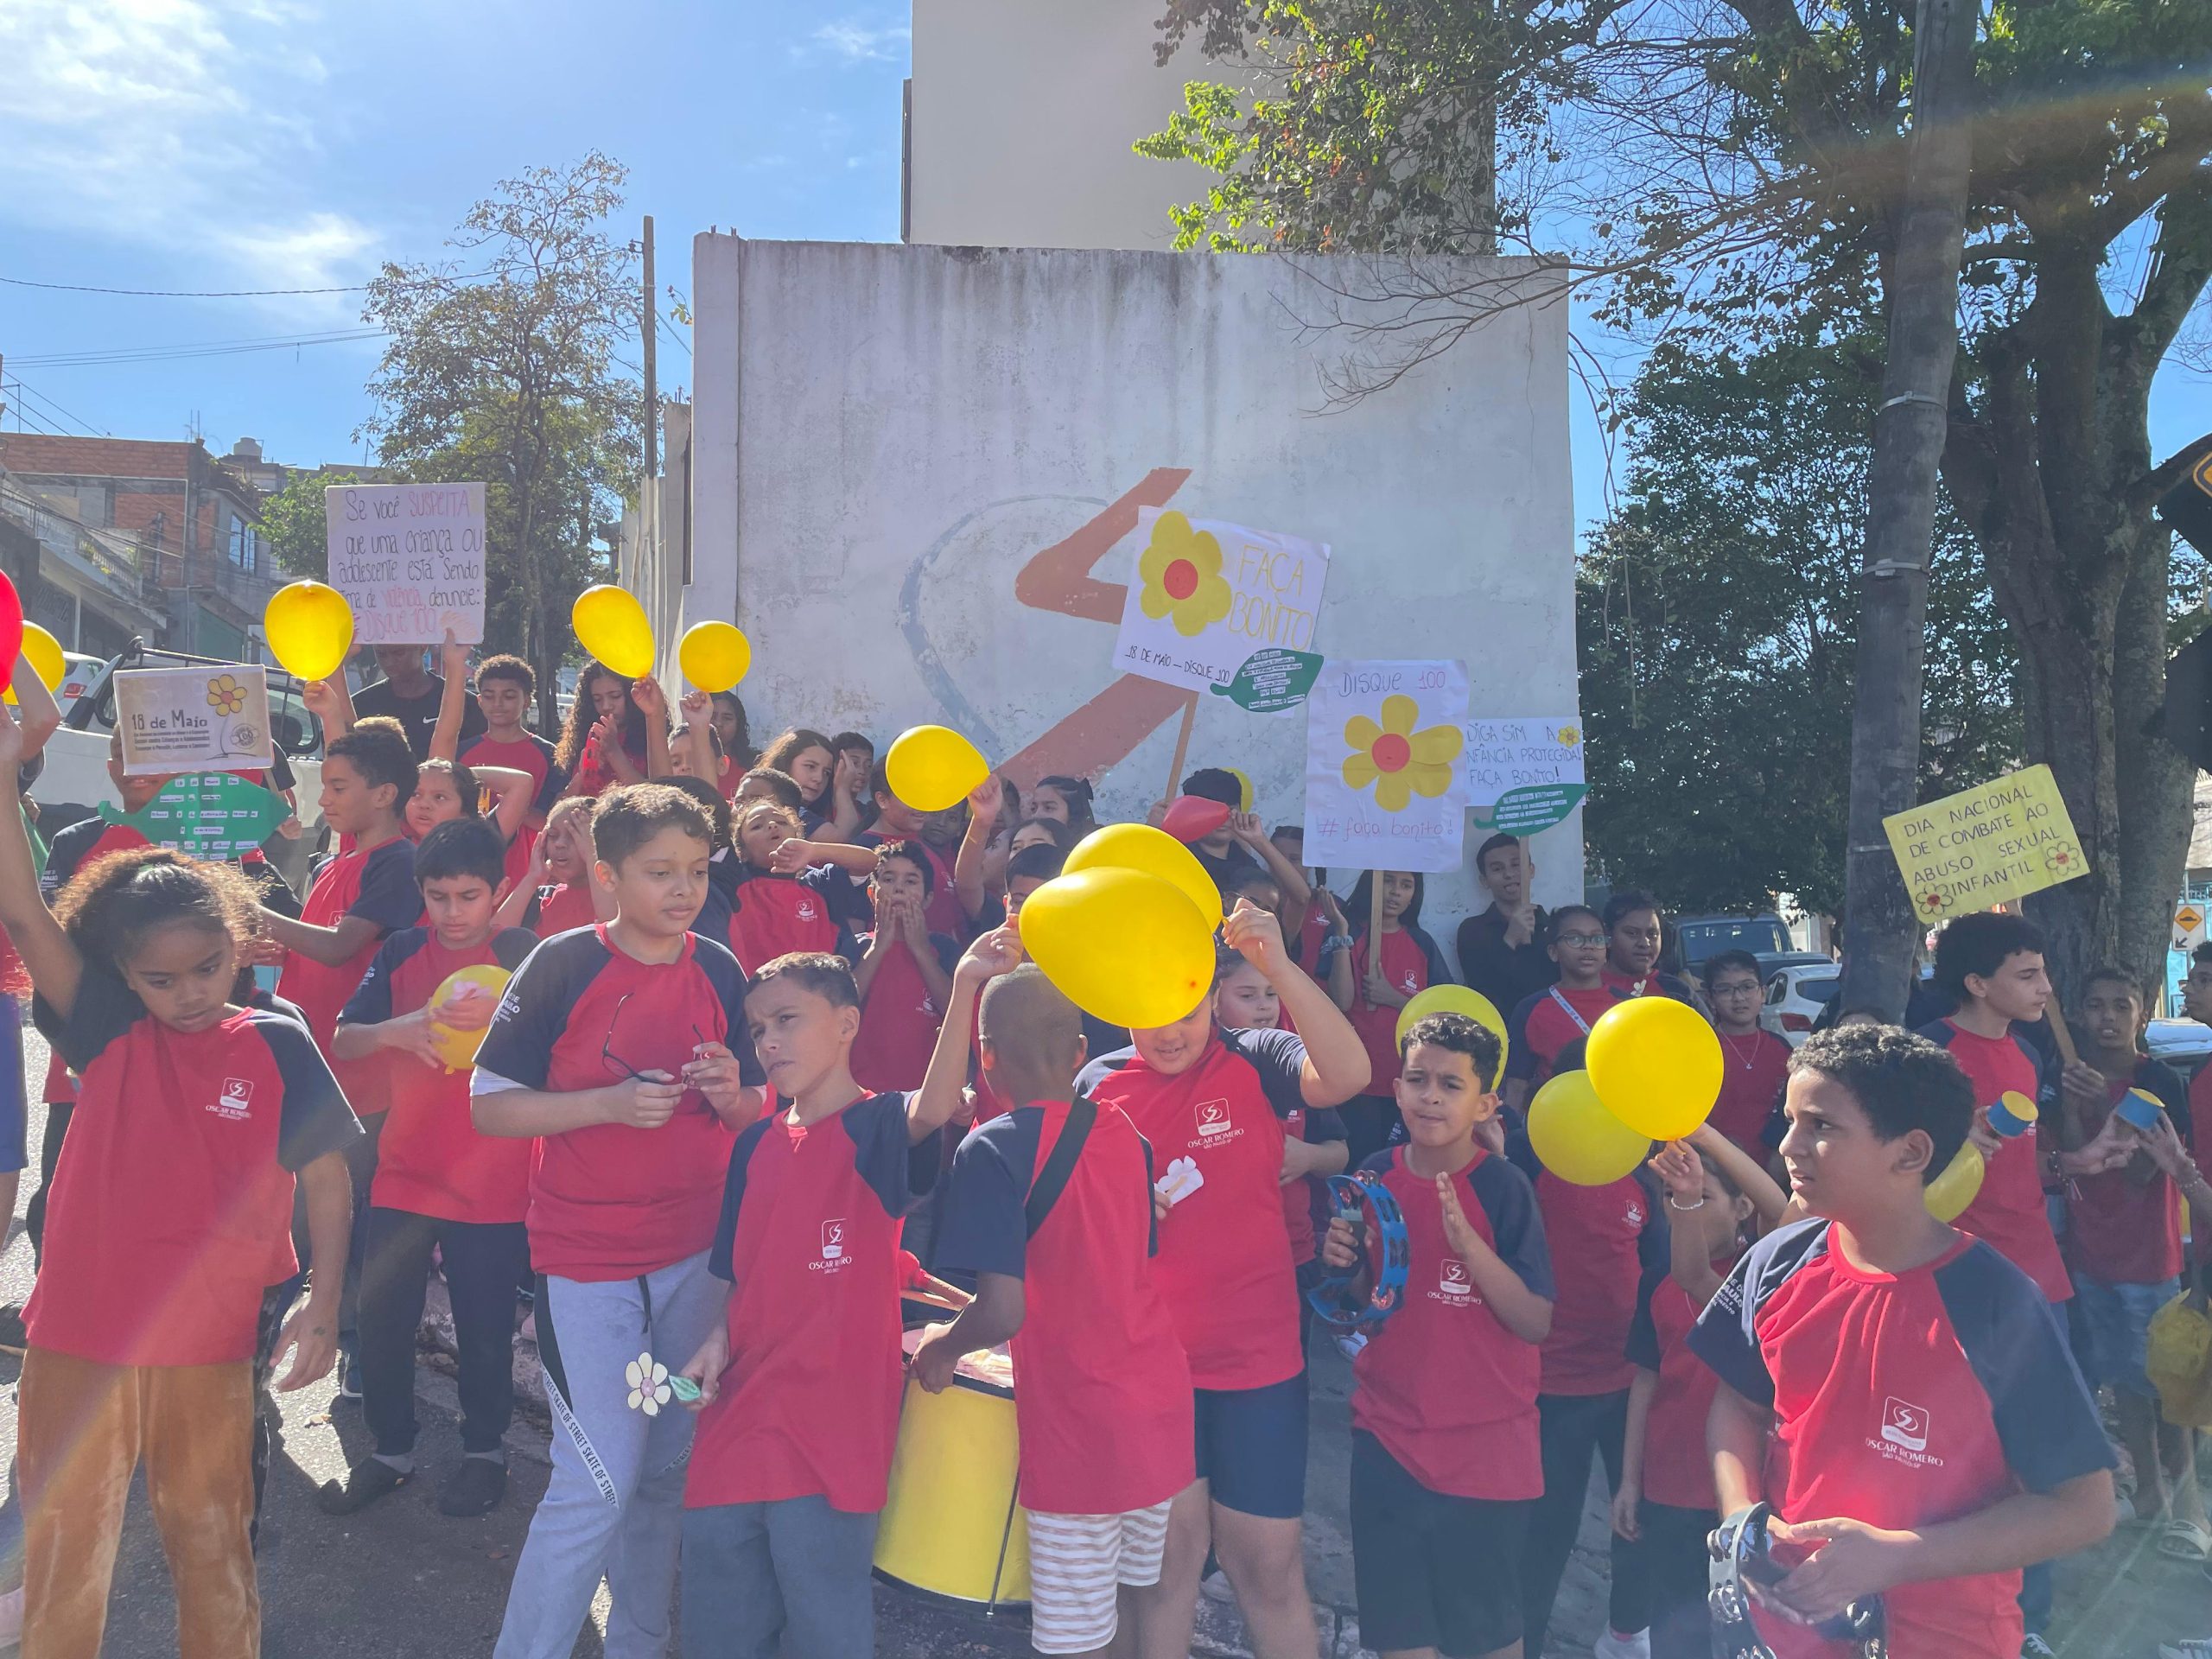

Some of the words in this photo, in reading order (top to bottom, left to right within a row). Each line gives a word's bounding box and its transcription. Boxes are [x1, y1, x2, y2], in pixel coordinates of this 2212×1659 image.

[346, 490, 367, 521] Se
[373, 496, 399, 519] você
[346, 535, 365, 559] que
[371, 535, 398, 554] uma
[338, 558, 397, 583] adolescente
[408, 557, 435, 582] está
[1238, 544, 1304, 605] FAÇA
[366, 588, 377, 608] de
[429, 586, 481, 607] denuncie:
[1125, 645, 1138, 659] 18
[1141, 649, 1151, 662] DE
[1153, 653, 1172, 667] MAIO
[1184, 659, 1214, 679] DISQUE
[1215, 670, 1230, 683] 100
[1417, 671, 1446, 690] 100
[132, 714, 145, 730] 18
[150, 716, 167, 728] de
[171, 709, 207, 728] Maio
[1467, 722, 1497, 742] DIGA
[1503, 724, 1527, 742] SIM
[1547, 725, 1556, 741] A
[1466, 743, 1515, 764] NFÂNCIA
[1521, 747, 1583, 762] PROTEGIDA!
[1470, 769, 1503, 790] FAÇA
[1511, 766, 1561, 785] BONITO!
[1904, 818, 1936, 838] DIA
[1949, 785, 2033, 824] NACIONAL
[1343, 817, 1381, 842] faça
[1909, 841, 1932, 859] DE
[1938, 813, 2014, 849] COMBATE
[2026, 802, 2050, 822] AO
[1913, 855, 1974, 886] ABUSO
[1998, 826, 2061, 858] SEXUAL
[1952, 860, 2035, 897] INFANTIL
[1187, 1136, 1213, 1148] OSCAR
[1214, 1128, 1244, 1142] ROMERO
[809, 1261, 835, 1271] OSCAR
[1427, 1291, 1452, 1300] OSCAR
[553, 1393, 566, 1414] SKATE
[563, 1412, 572, 1424] OF
[569, 1422, 588, 1448] STREET
[582, 1446, 602, 1471] SKATE
[594, 1469, 607, 1480] OF
[1866, 1437, 1897, 1453] OSCAR
[1899, 1447, 1943, 1467] ROMERO
